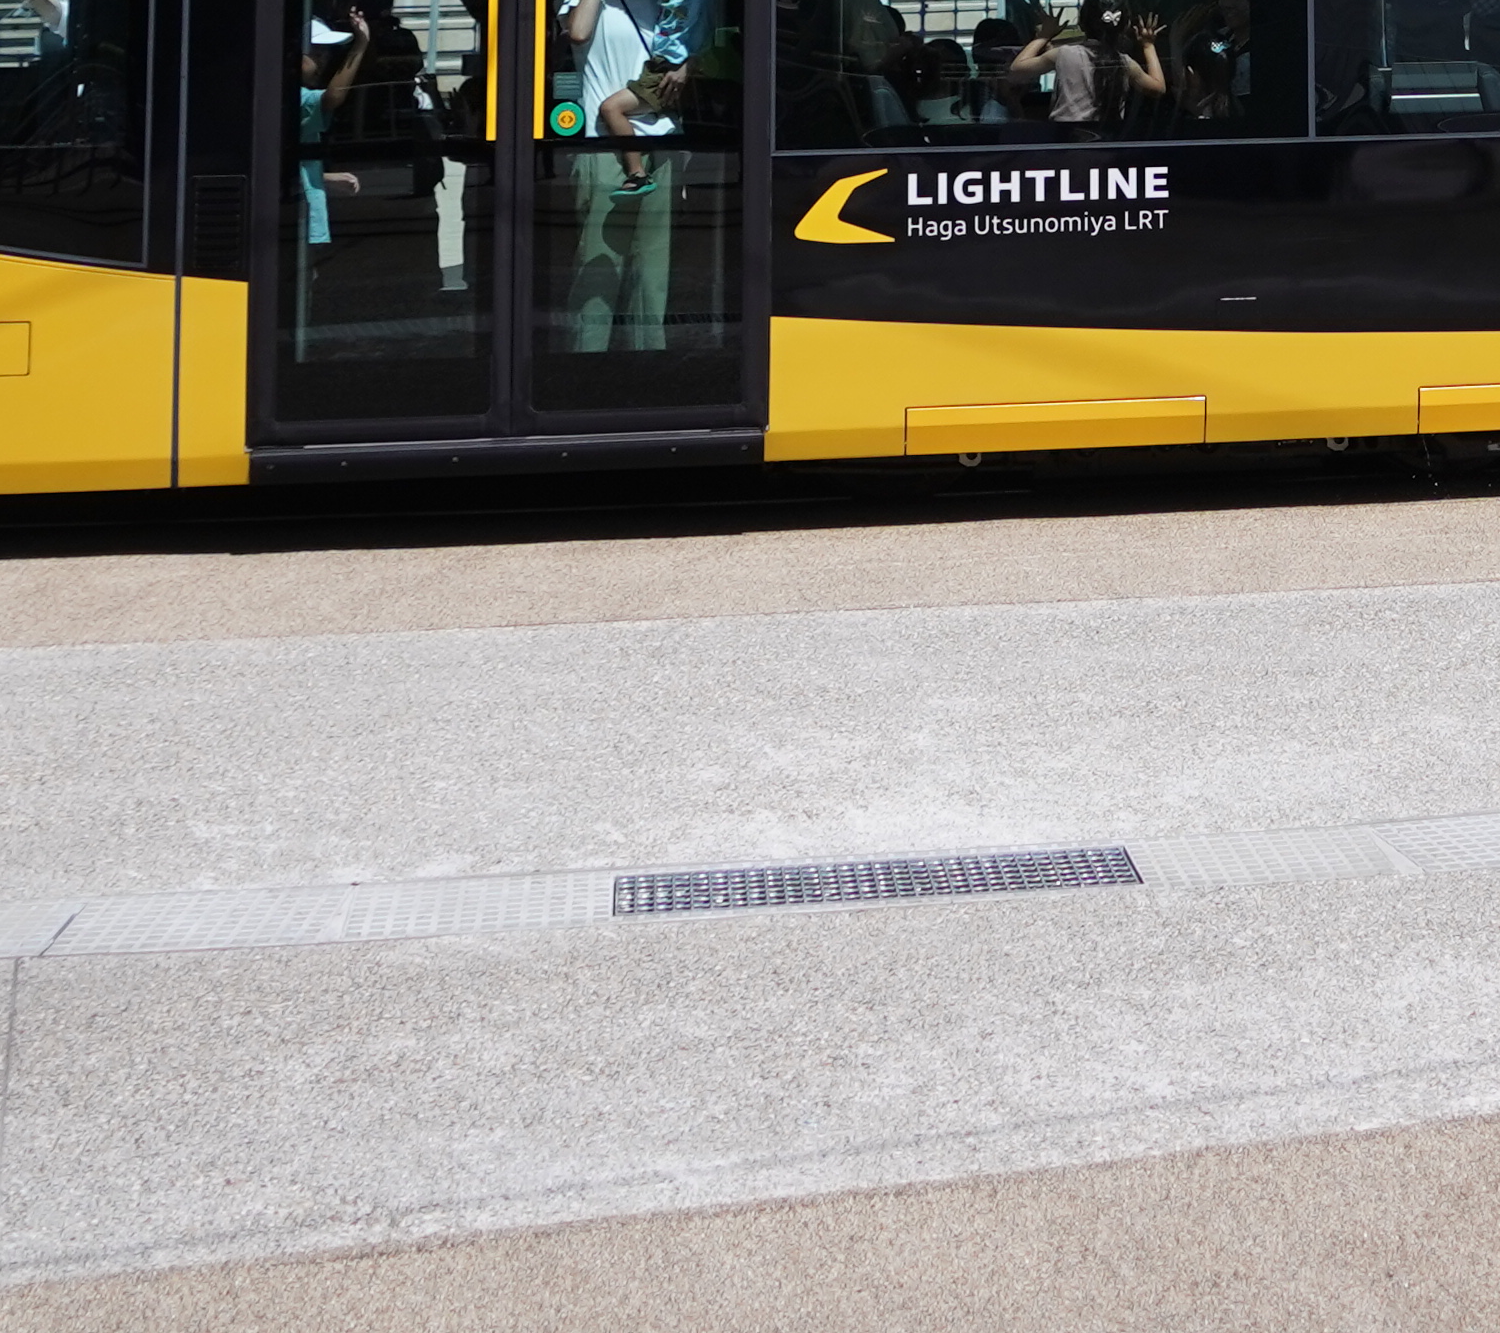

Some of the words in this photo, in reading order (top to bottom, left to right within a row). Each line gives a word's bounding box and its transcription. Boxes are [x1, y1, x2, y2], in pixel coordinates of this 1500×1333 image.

[907, 166, 1170, 206] LIGHTLINE
[907, 217, 967, 241] Haga
[974, 211, 1117, 236] Utsunomiya
[1124, 209, 1170, 230] LRT
